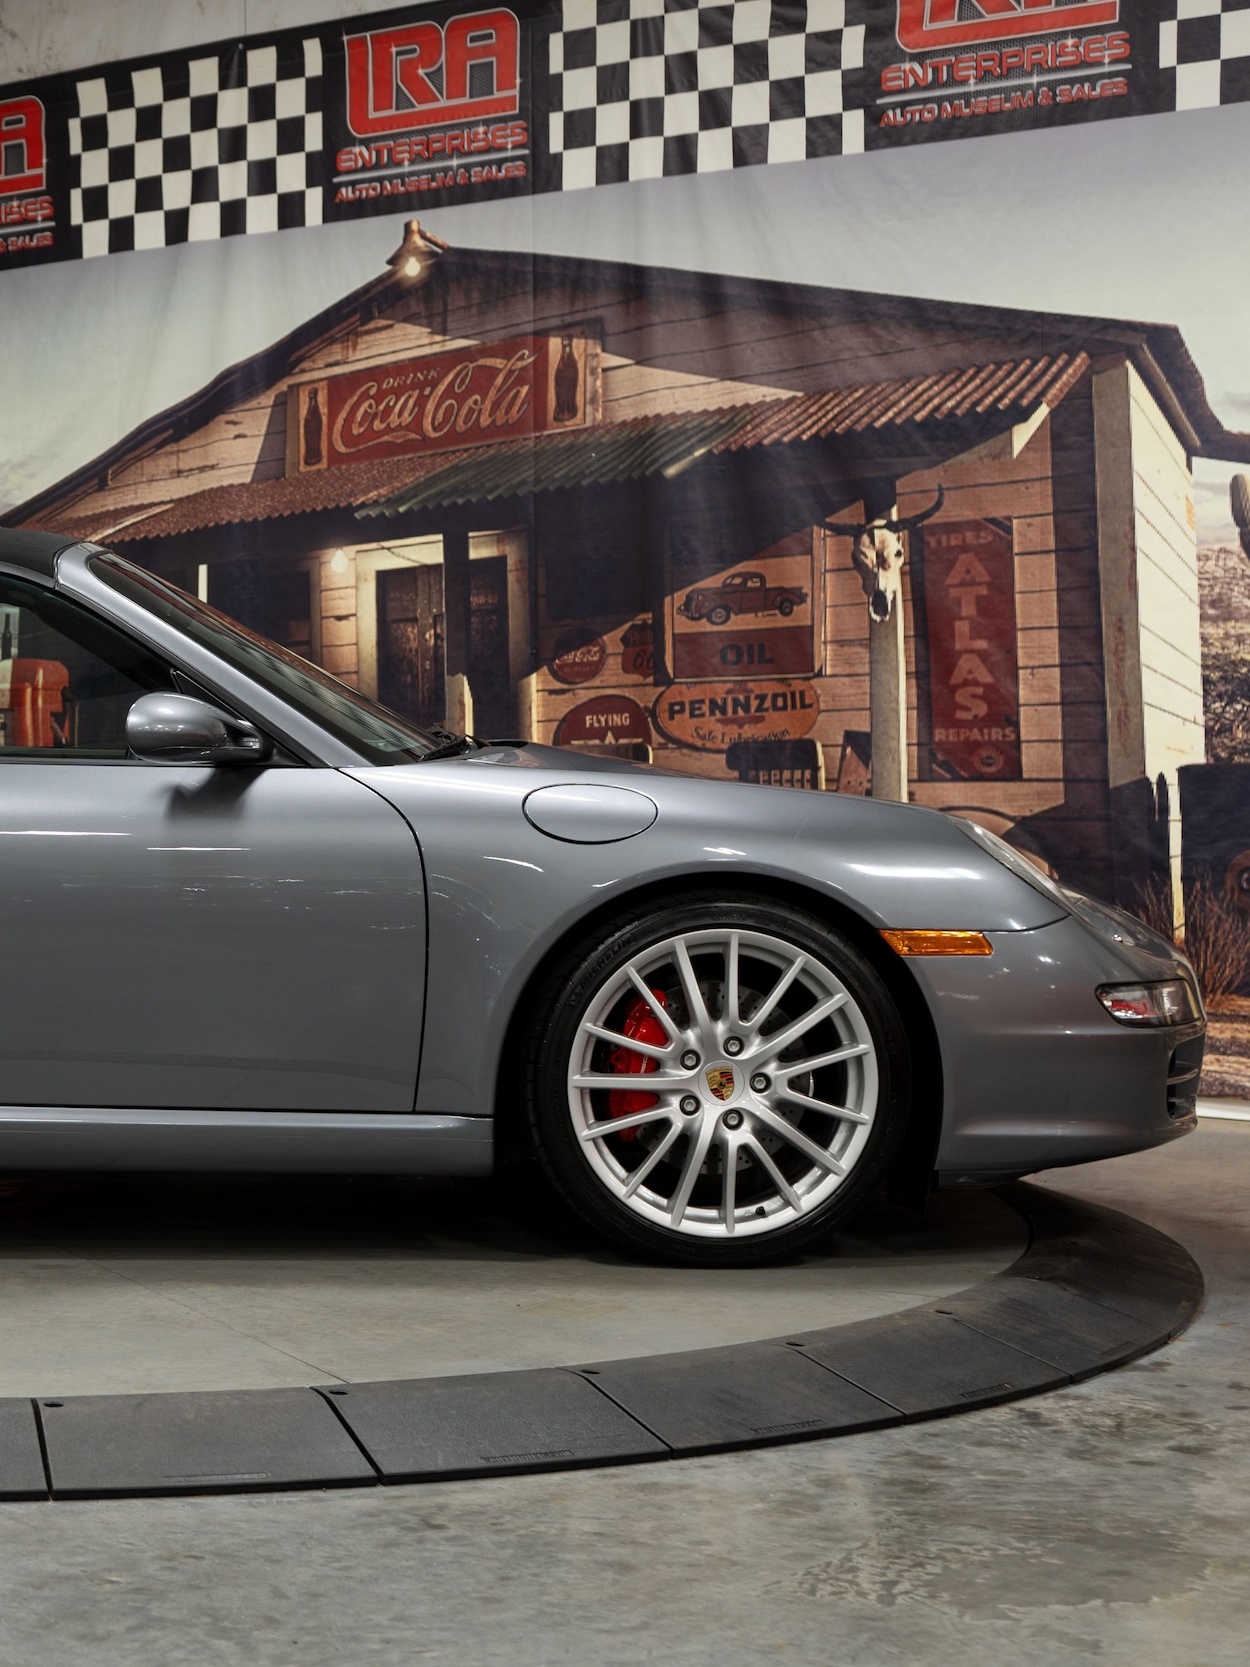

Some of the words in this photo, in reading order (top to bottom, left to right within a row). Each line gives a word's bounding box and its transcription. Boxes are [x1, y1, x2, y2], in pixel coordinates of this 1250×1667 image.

[343, 6, 521, 139] LRA
[880, 30, 1131, 93] ENTERPRISES
[879, 101, 939, 128] AUTO
[940, 90, 1034, 119] MUSEUM
[1037, 86, 1054, 107] &
[1055, 77, 1129, 104] SALES
[335, 120, 529, 172] ENTERPRISES
[333, 180, 381, 204] AUTO
[381, 171, 455, 196] MUSEUM
[455, 168, 469, 185] &
[470, 160, 527, 184] SALES
[6, 231, 55, 252] SALES
[382, 366, 441, 390] DRINK
[925, 530, 994, 548] TIRES
[943, 551, 996, 720] ATLAS
[718, 642, 776, 667] OIL
[667, 689, 815, 722] PENNZOIL
[585, 712, 630, 729] FLYING
[691, 726, 719, 744] Safe
[934, 726, 1017, 743] REPAIRS
